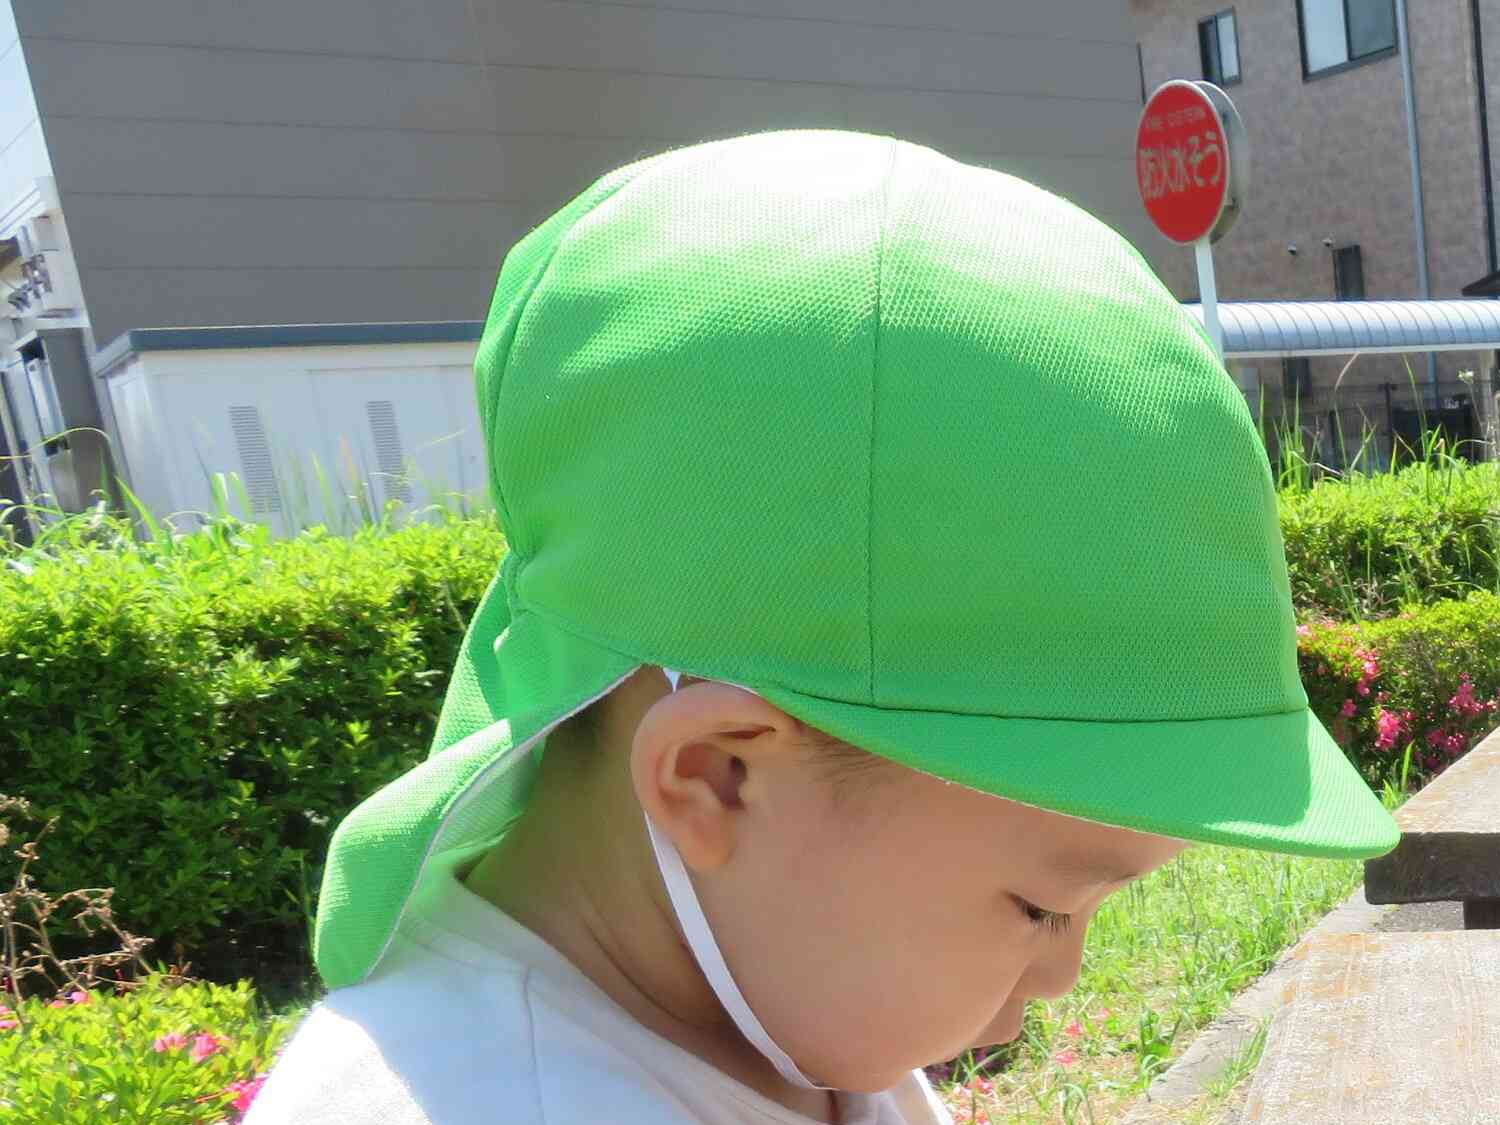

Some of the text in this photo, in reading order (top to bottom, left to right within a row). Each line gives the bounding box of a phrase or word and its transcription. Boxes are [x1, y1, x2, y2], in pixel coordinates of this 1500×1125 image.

[1139, 130, 1222, 198] 防火水そう
